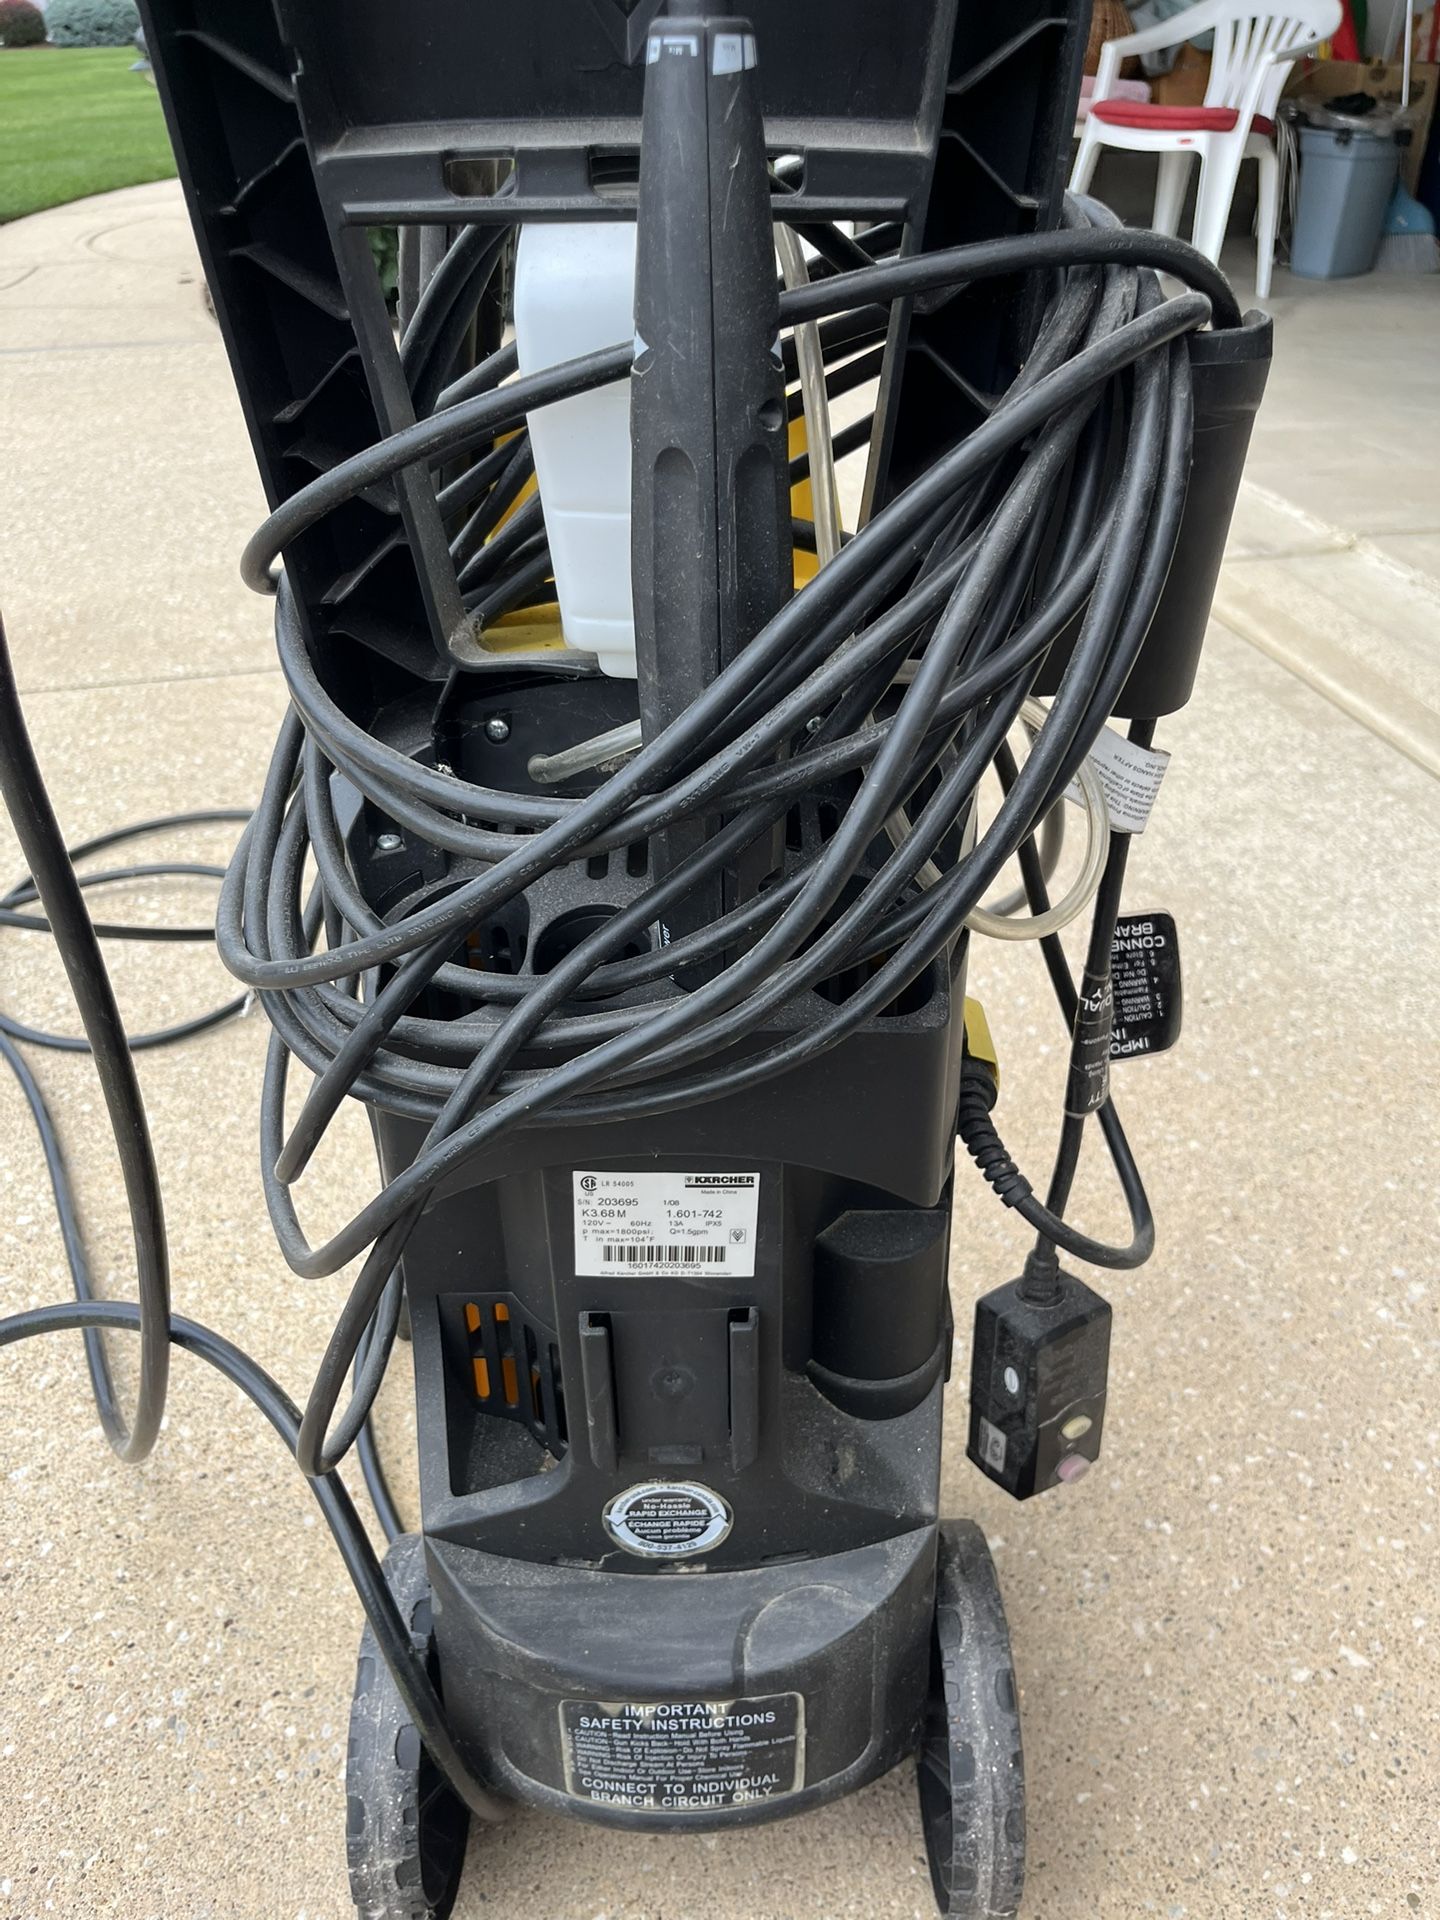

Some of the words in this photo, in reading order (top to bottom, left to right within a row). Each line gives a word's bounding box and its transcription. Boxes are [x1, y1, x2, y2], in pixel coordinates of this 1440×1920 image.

[1122, 1004, 1151, 1013] CAUTION
[1124, 1012, 1152, 1022] CAUTION
[598, 1198, 639, 1206] 203695
[582, 1209, 615, 1218] K3.68
[617, 1210, 626, 1218] M
[667, 1210, 723, 1218] 1.601-742
[625, 1703, 729, 1717] IMPORTANT
[580, 1717, 644, 1730] SAFETY
[651, 1712, 776, 1730] INSTRUCTIONS
[732, 1740, 769, 1749] Flammable
[771, 1735, 796, 1744] Liquids
[603, 1759, 638, 1768] Discharge
[582, 1777, 657, 1794] CONNECT
[664, 1783, 685, 1794] TO
[692, 1773, 780, 1794] INDIVIDUAL
[591, 1790, 654, 1807] BRANCH
[662, 1794, 725, 1807] CIRCUIT
[732, 1786, 772, 1802] ONLY
